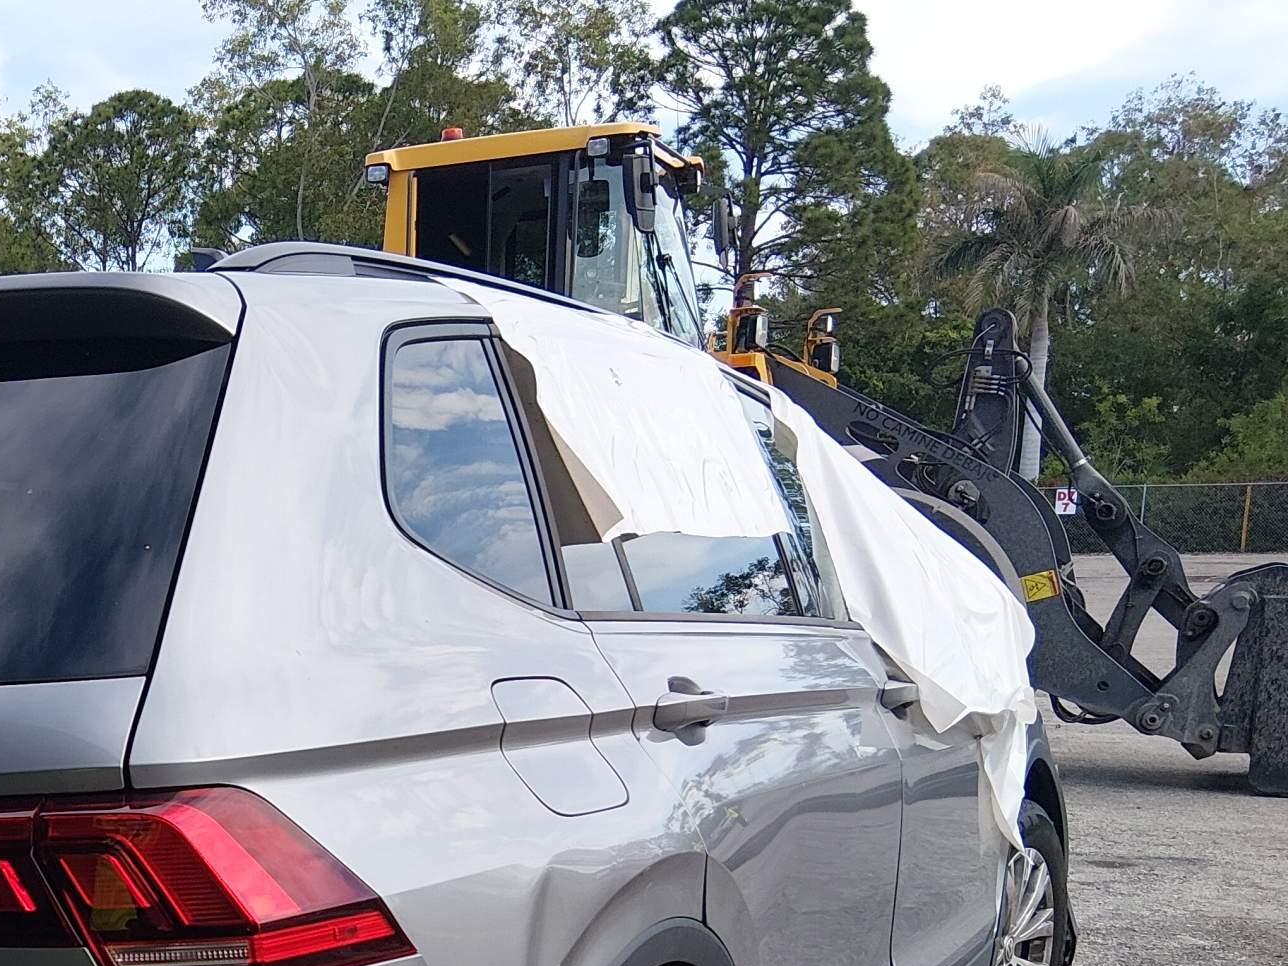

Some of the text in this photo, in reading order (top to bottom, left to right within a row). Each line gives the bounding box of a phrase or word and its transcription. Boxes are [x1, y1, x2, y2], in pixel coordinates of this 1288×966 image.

[854, 402, 879, 422] NO
[882, 417, 941, 452] CAMINE
[1062, 503, 1070, 512] 7
